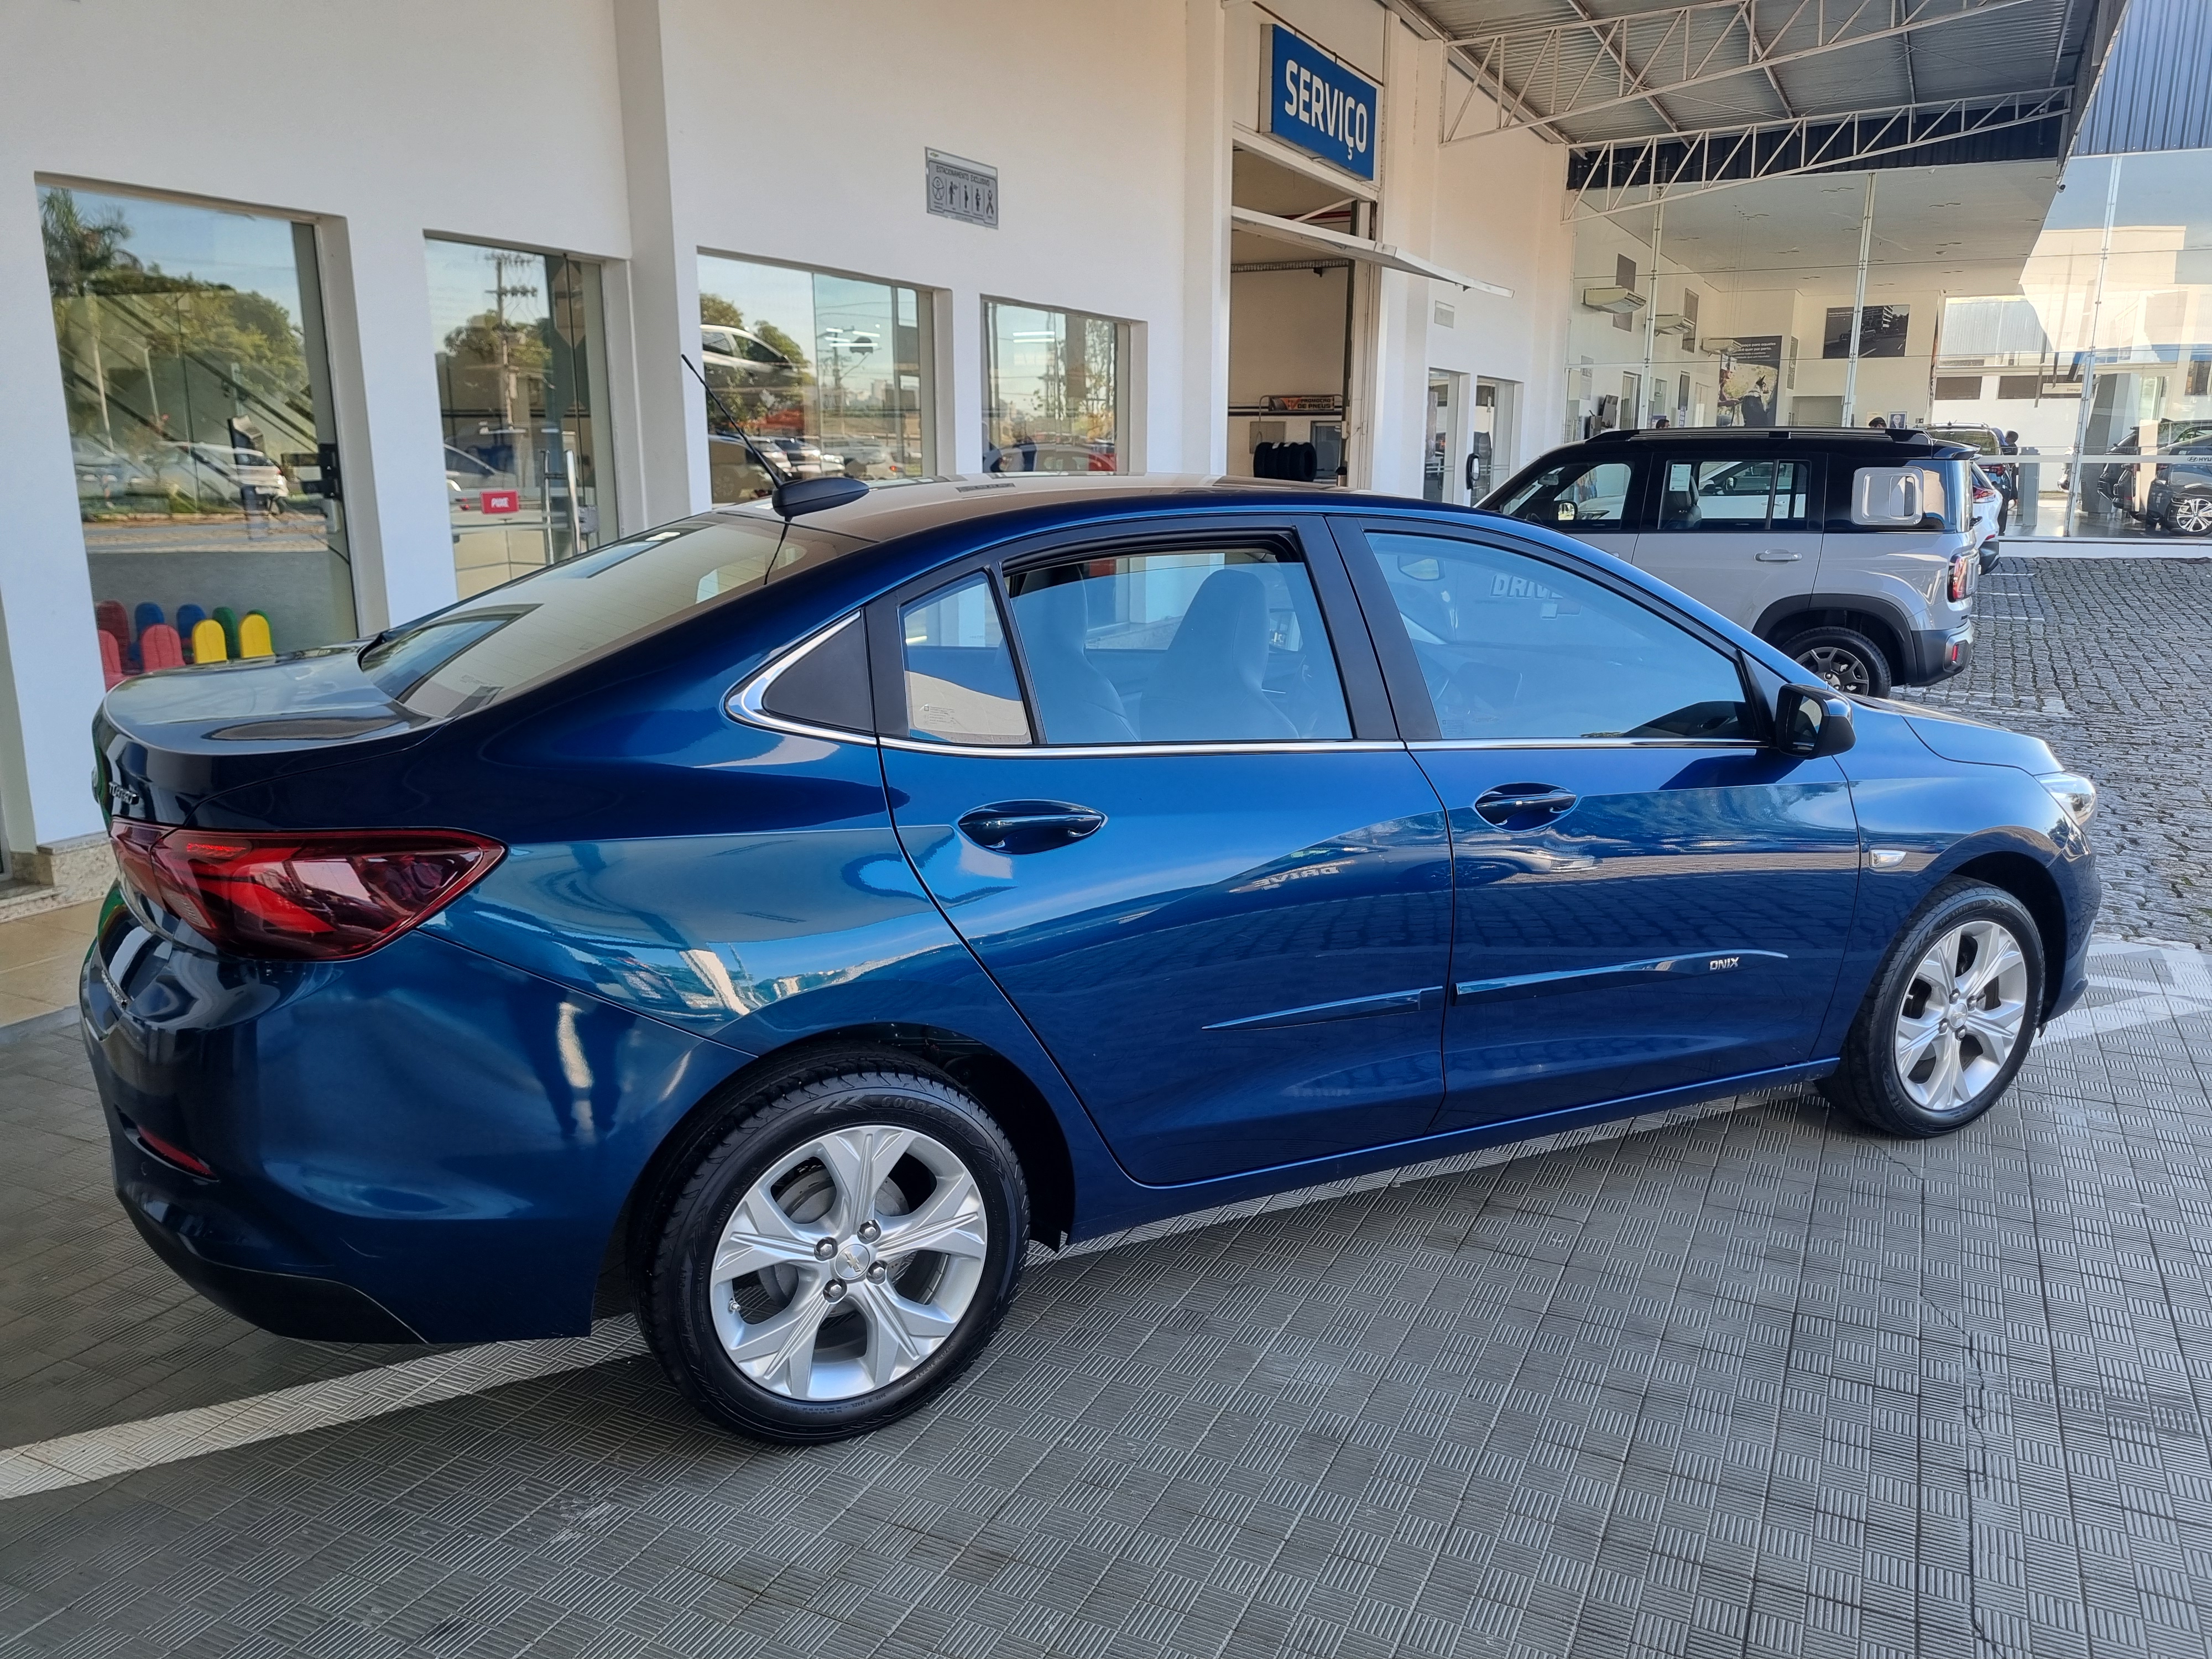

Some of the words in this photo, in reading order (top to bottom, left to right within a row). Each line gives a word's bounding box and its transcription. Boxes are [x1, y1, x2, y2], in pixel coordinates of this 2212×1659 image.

[1285, 59, 1367, 161] SERVIÇO
[1490, 573, 1564, 599] DRIV
[1709, 957, 1739, 971] ONIX
